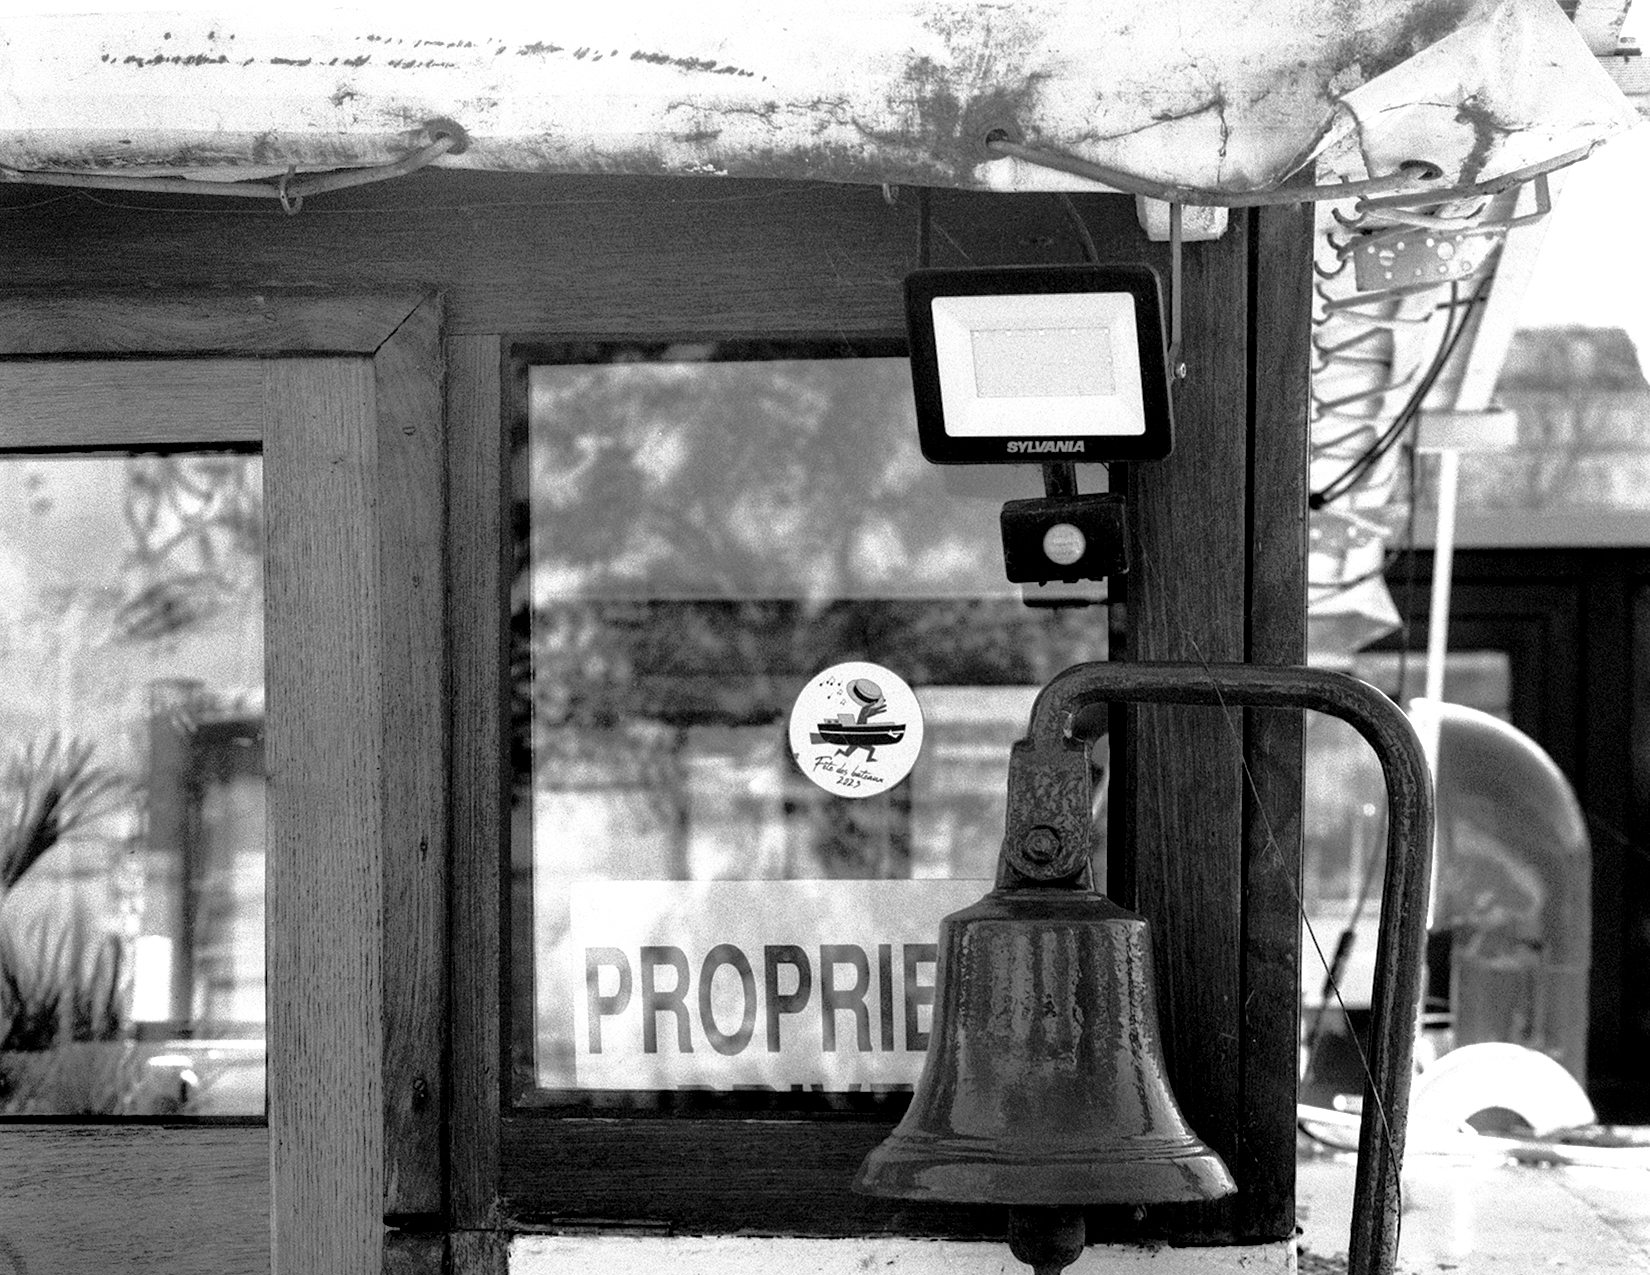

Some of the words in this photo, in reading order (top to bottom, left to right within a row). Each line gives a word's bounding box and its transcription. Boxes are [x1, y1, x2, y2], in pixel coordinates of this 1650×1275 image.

[1006, 440, 1085, 453] SYLVANIA
[836, 762, 848, 776] des
[850, 765, 885, 783] bateaux
[836, 776, 861, 789] 2023
